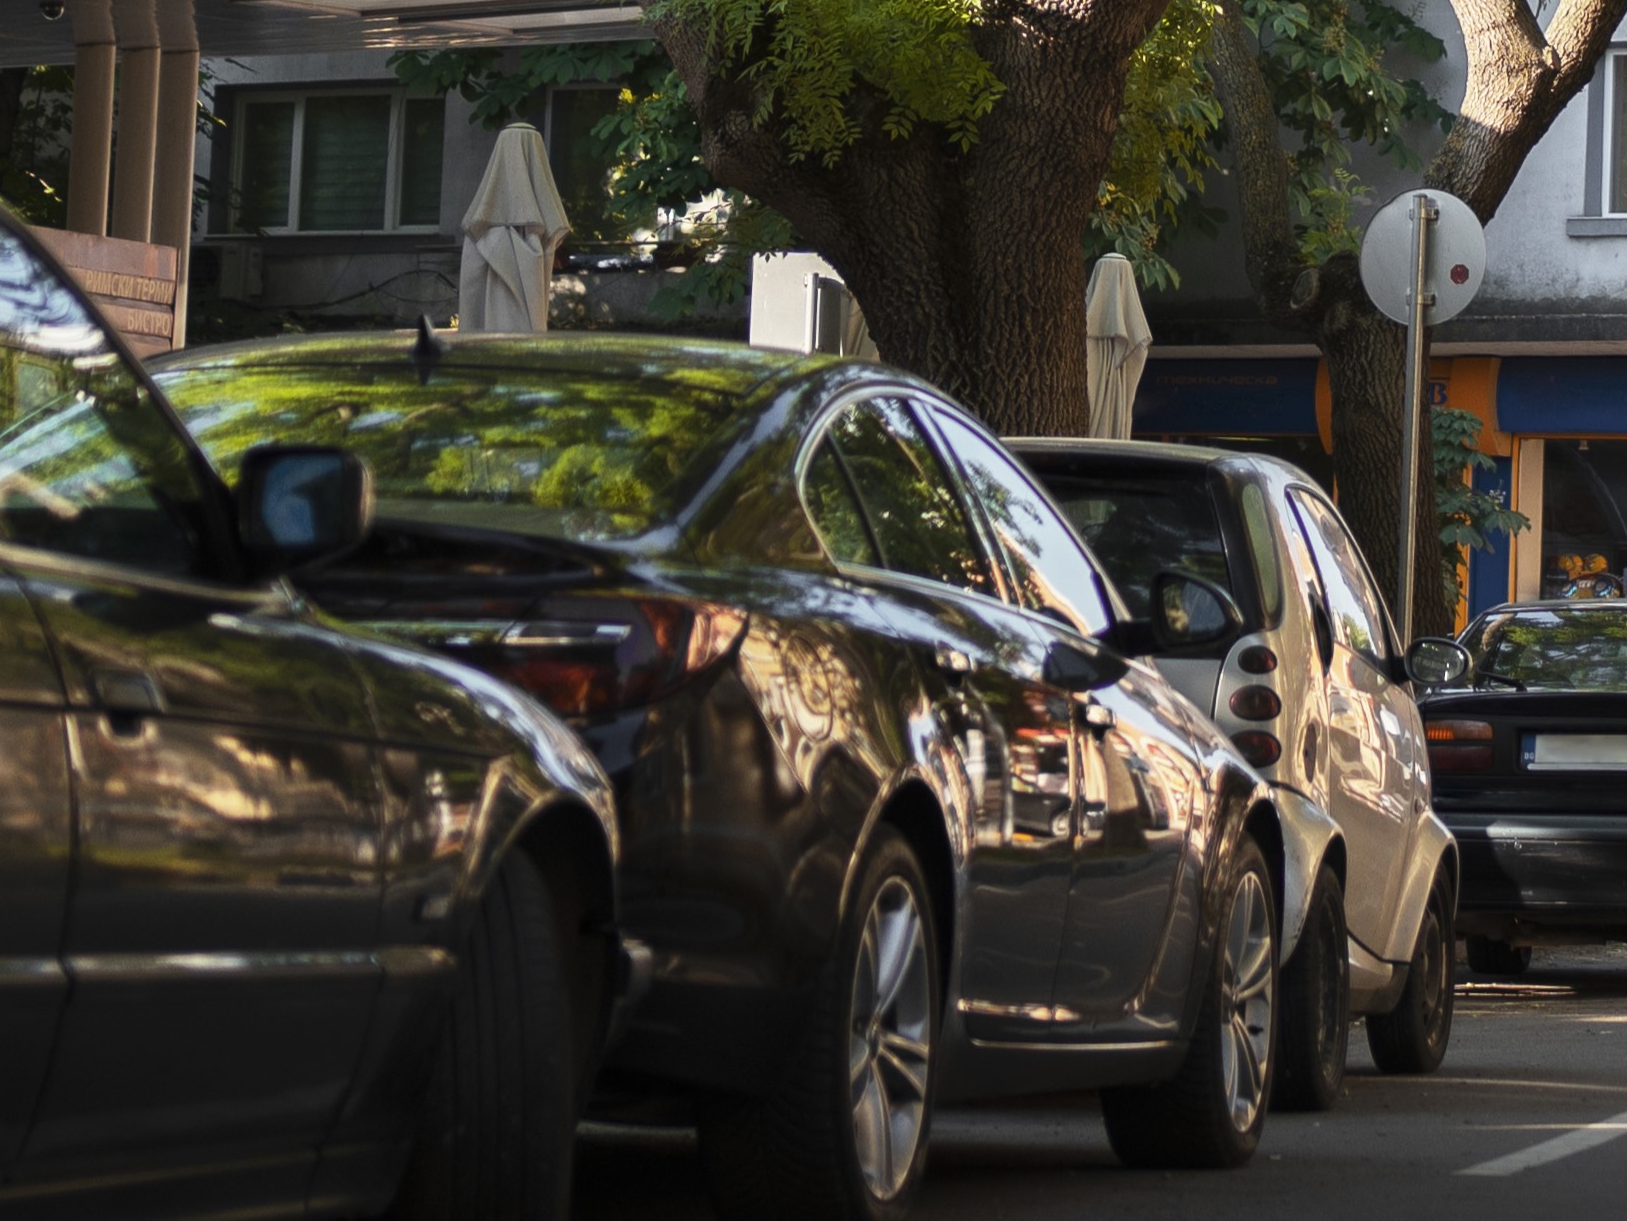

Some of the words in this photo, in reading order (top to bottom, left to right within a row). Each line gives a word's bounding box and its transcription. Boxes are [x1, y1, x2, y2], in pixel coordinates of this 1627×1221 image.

[85, 270, 133, 297] РИМСКИ
[136, 279, 173, 304] ТЕРМИ
[127, 312, 171, 335] БИСТРО
